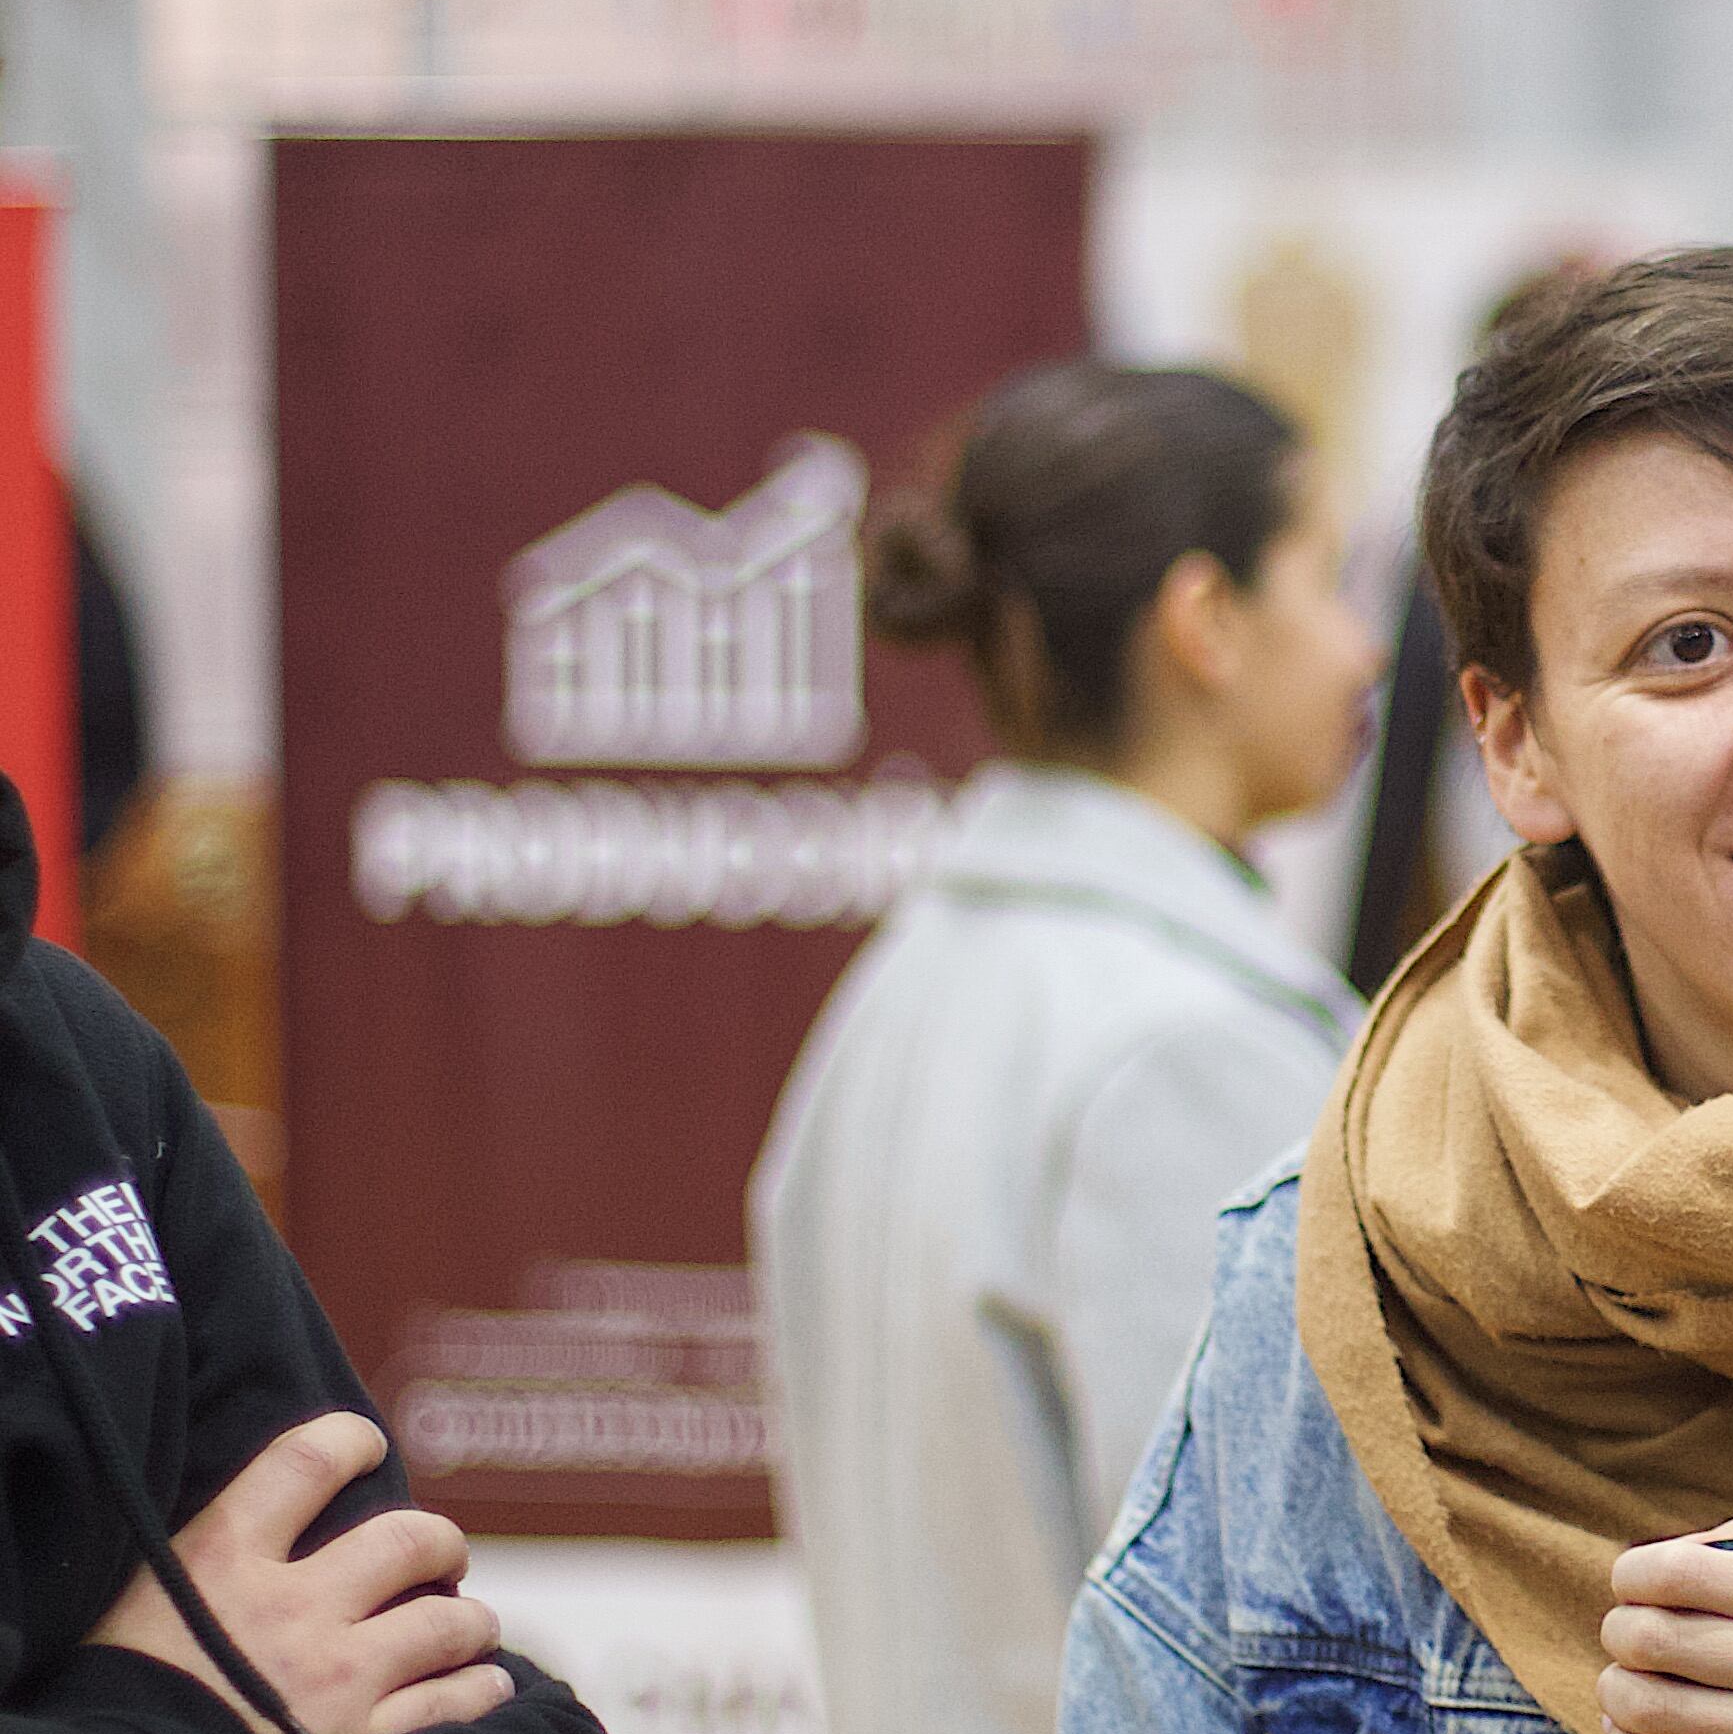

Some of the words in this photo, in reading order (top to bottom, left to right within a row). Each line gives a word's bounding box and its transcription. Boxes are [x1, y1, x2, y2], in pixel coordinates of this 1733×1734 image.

[354, 759, 945, 932] PRODUCCIÓ
[27, 1184, 138, 1253] THE
[61, 1262, 176, 1332] FACE
